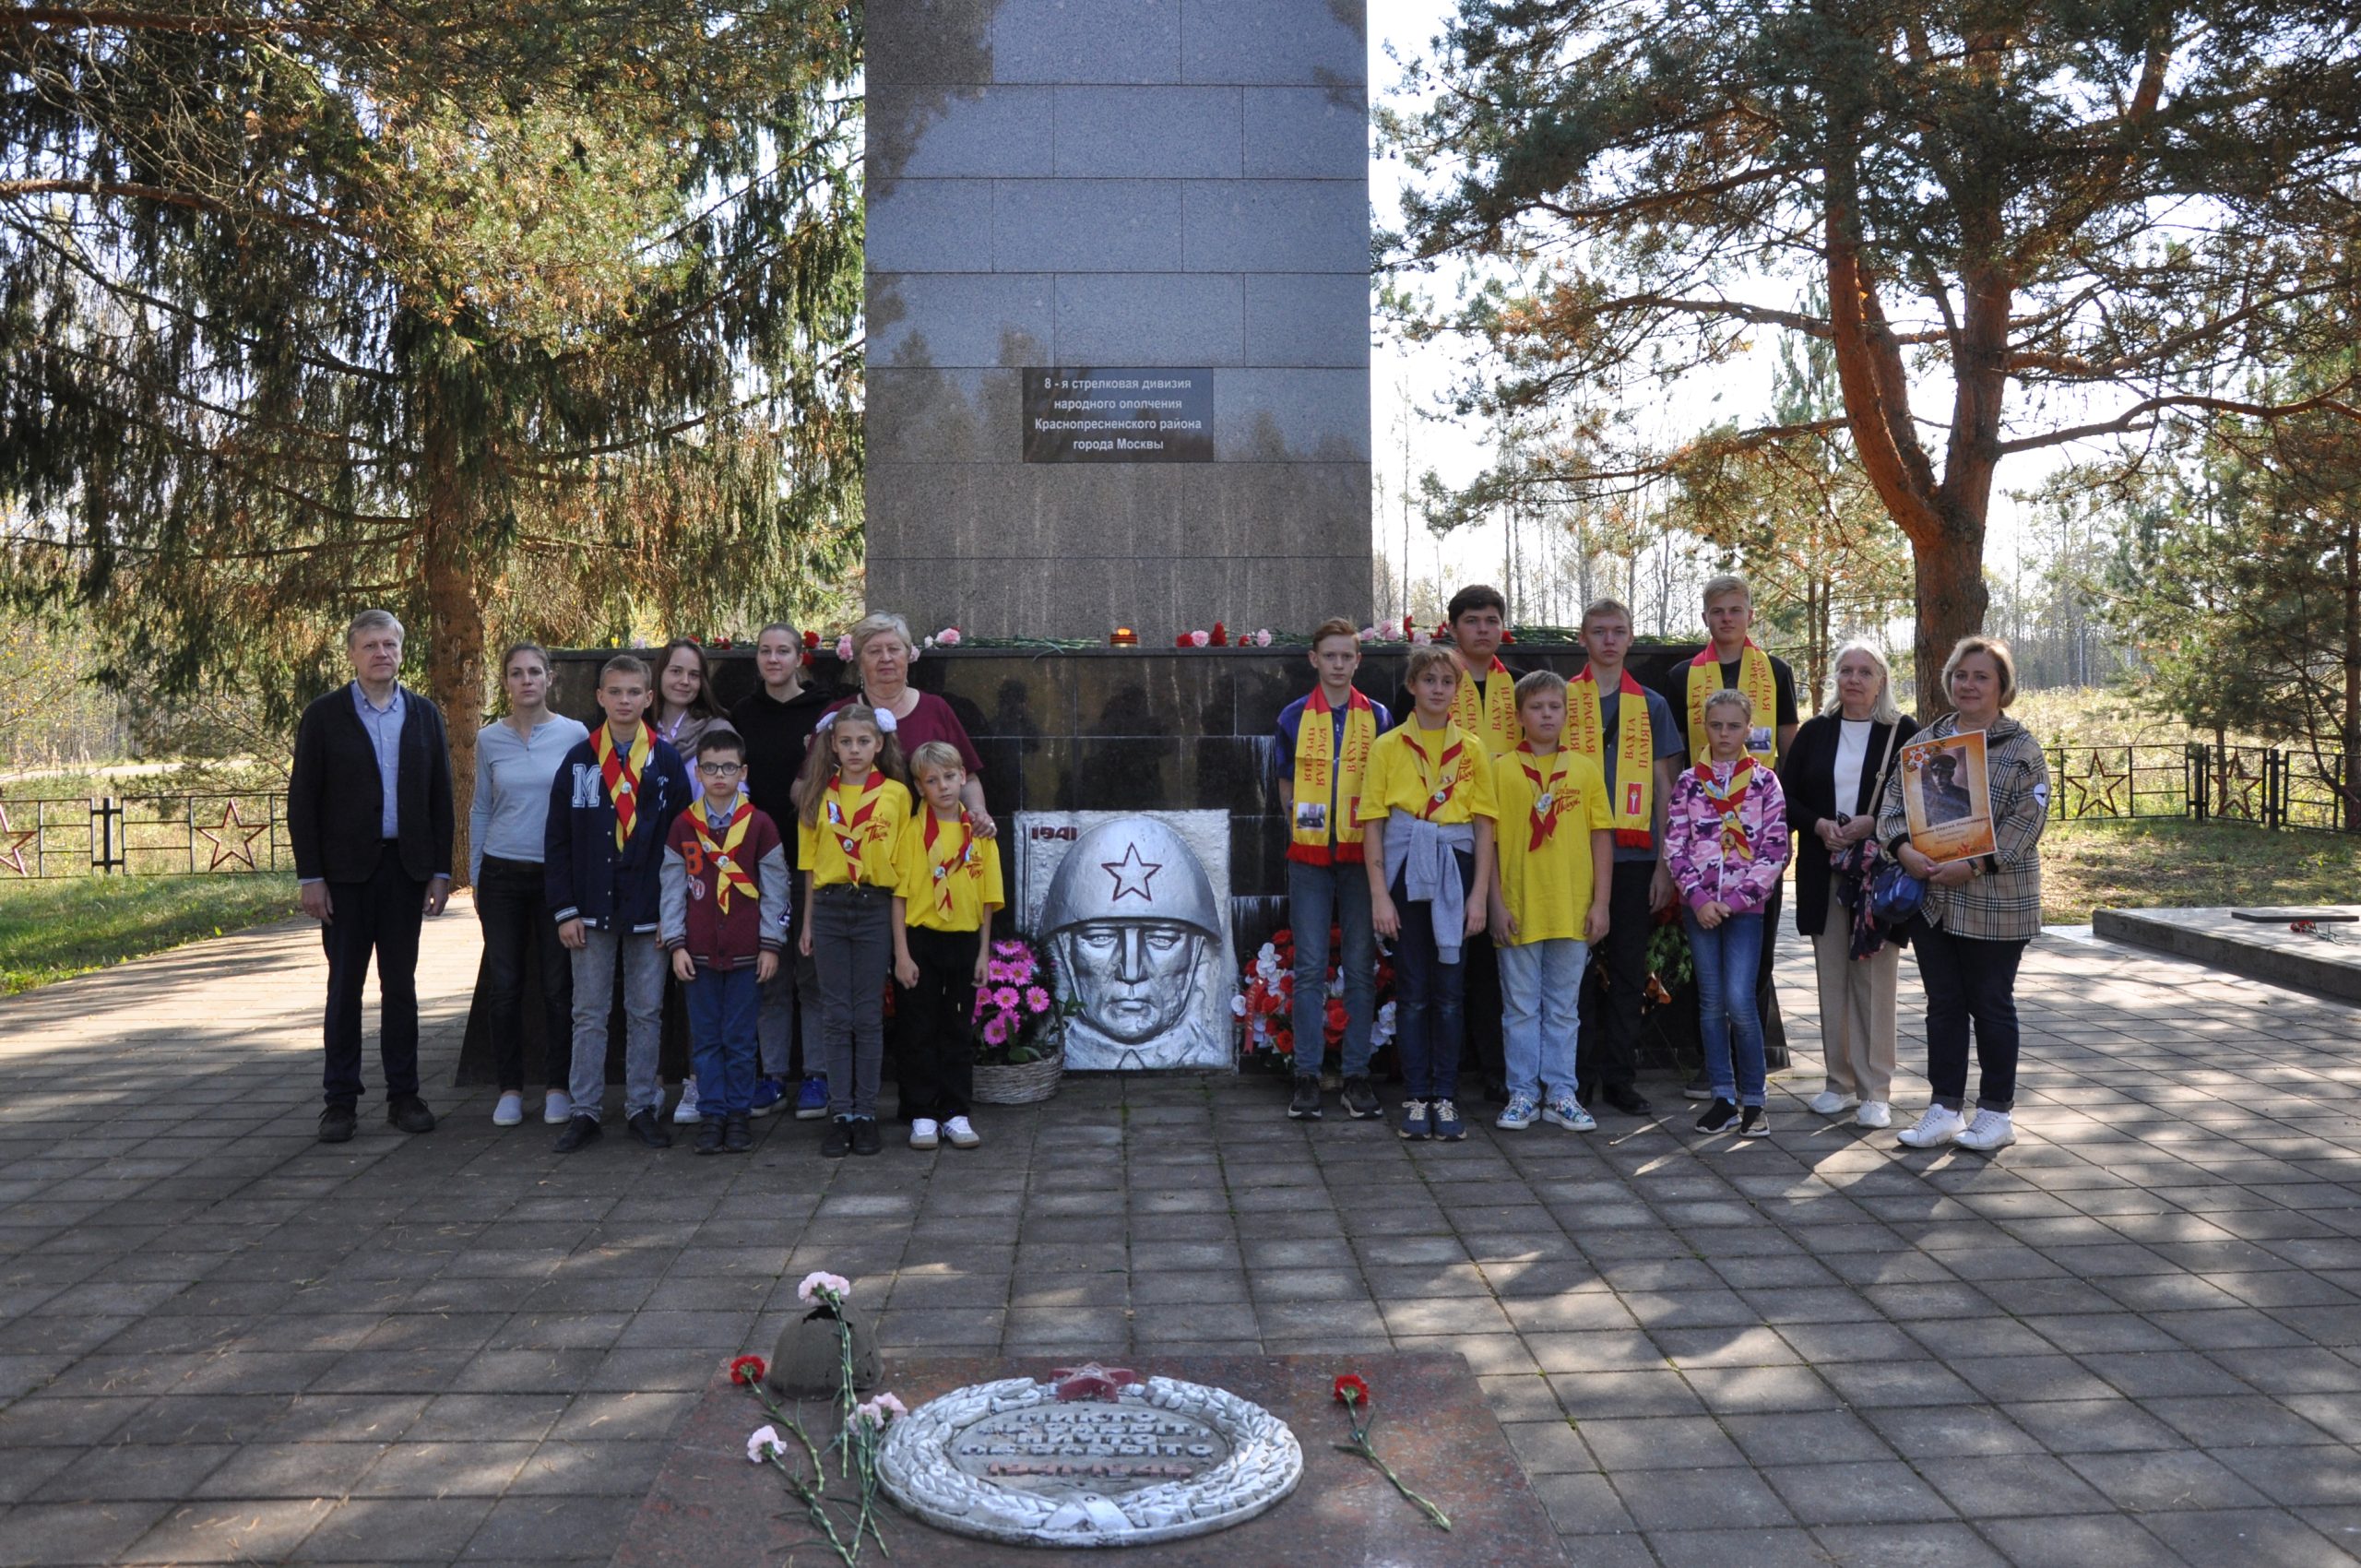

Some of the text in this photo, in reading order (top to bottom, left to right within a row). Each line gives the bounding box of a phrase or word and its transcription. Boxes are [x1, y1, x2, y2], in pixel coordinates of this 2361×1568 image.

[1072, 380, 1139, 392] стрелковая
[1141, 380, 1192, 390] дивизия
[1054, 400, 1182, 411] народного ополчения
[1034, 417, 1202, 432] Краснопресненского района
[1073, 437, 1164, 452] города Москвы
[1501, 686, 1514, 740] ПАМЯТИ
[1569, 697, 1580, 751] ПРЕСНЯ
[1582, 692, 1596, 754] КРАСНАЯ
[1624, 718, 1636, 759] ВАХТА
[1638, 711, 1650, 768] ПАМЯТИ
[572, 763, 601, 808] M
[1031, 826, 1078, 841] 1941
[681, 840, 704, 875] B
[1017, 1412, 1160, 1424] НИКТО
[1028, 1443, 1216, 1457] ЗАБЫТО
